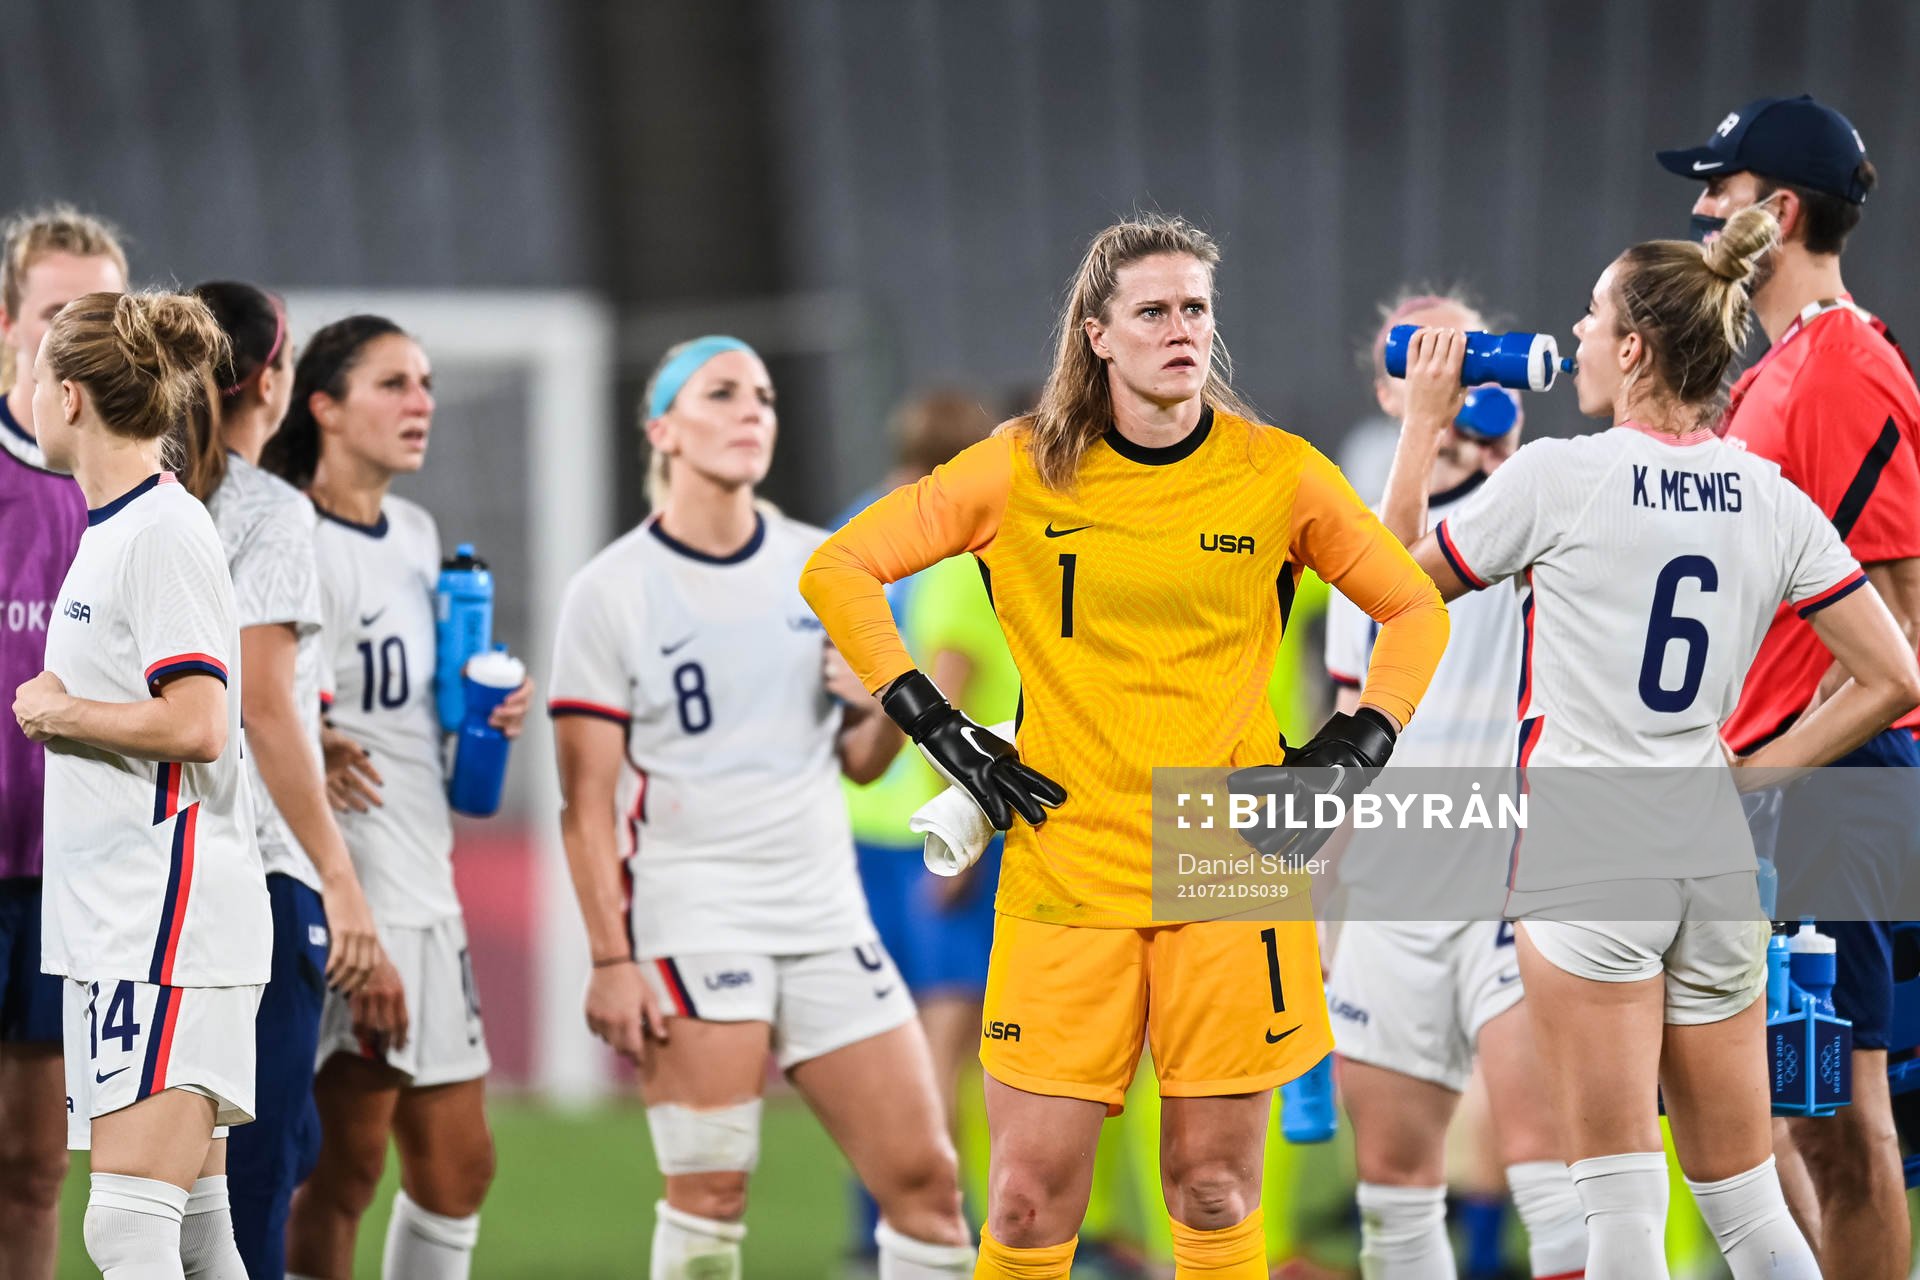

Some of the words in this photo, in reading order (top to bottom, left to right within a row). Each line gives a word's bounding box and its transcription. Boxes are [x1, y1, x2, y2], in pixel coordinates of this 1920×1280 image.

[1200, 533, 1255, 555] USA
[64, 598, 91, 624] USA
[1058, 553, 1077, 638] 1
[1638, 554, 1718, 713] 6
[358, 636, 409, 713] 10
[673, 662, 713, 735] 8
[1260, 927, 1286, 1014] 1
[88, 979, 141, 1060] 14
[984, 1020, 1021, 1042] USA
[1776, 1034, 1784, 1057] 2020
[1833, 1035, 1841, 1068] TOKYO
[1776, 1060, 1784, 1093] TOKYO
[1833, 1070, 1841, 1094] 2020
